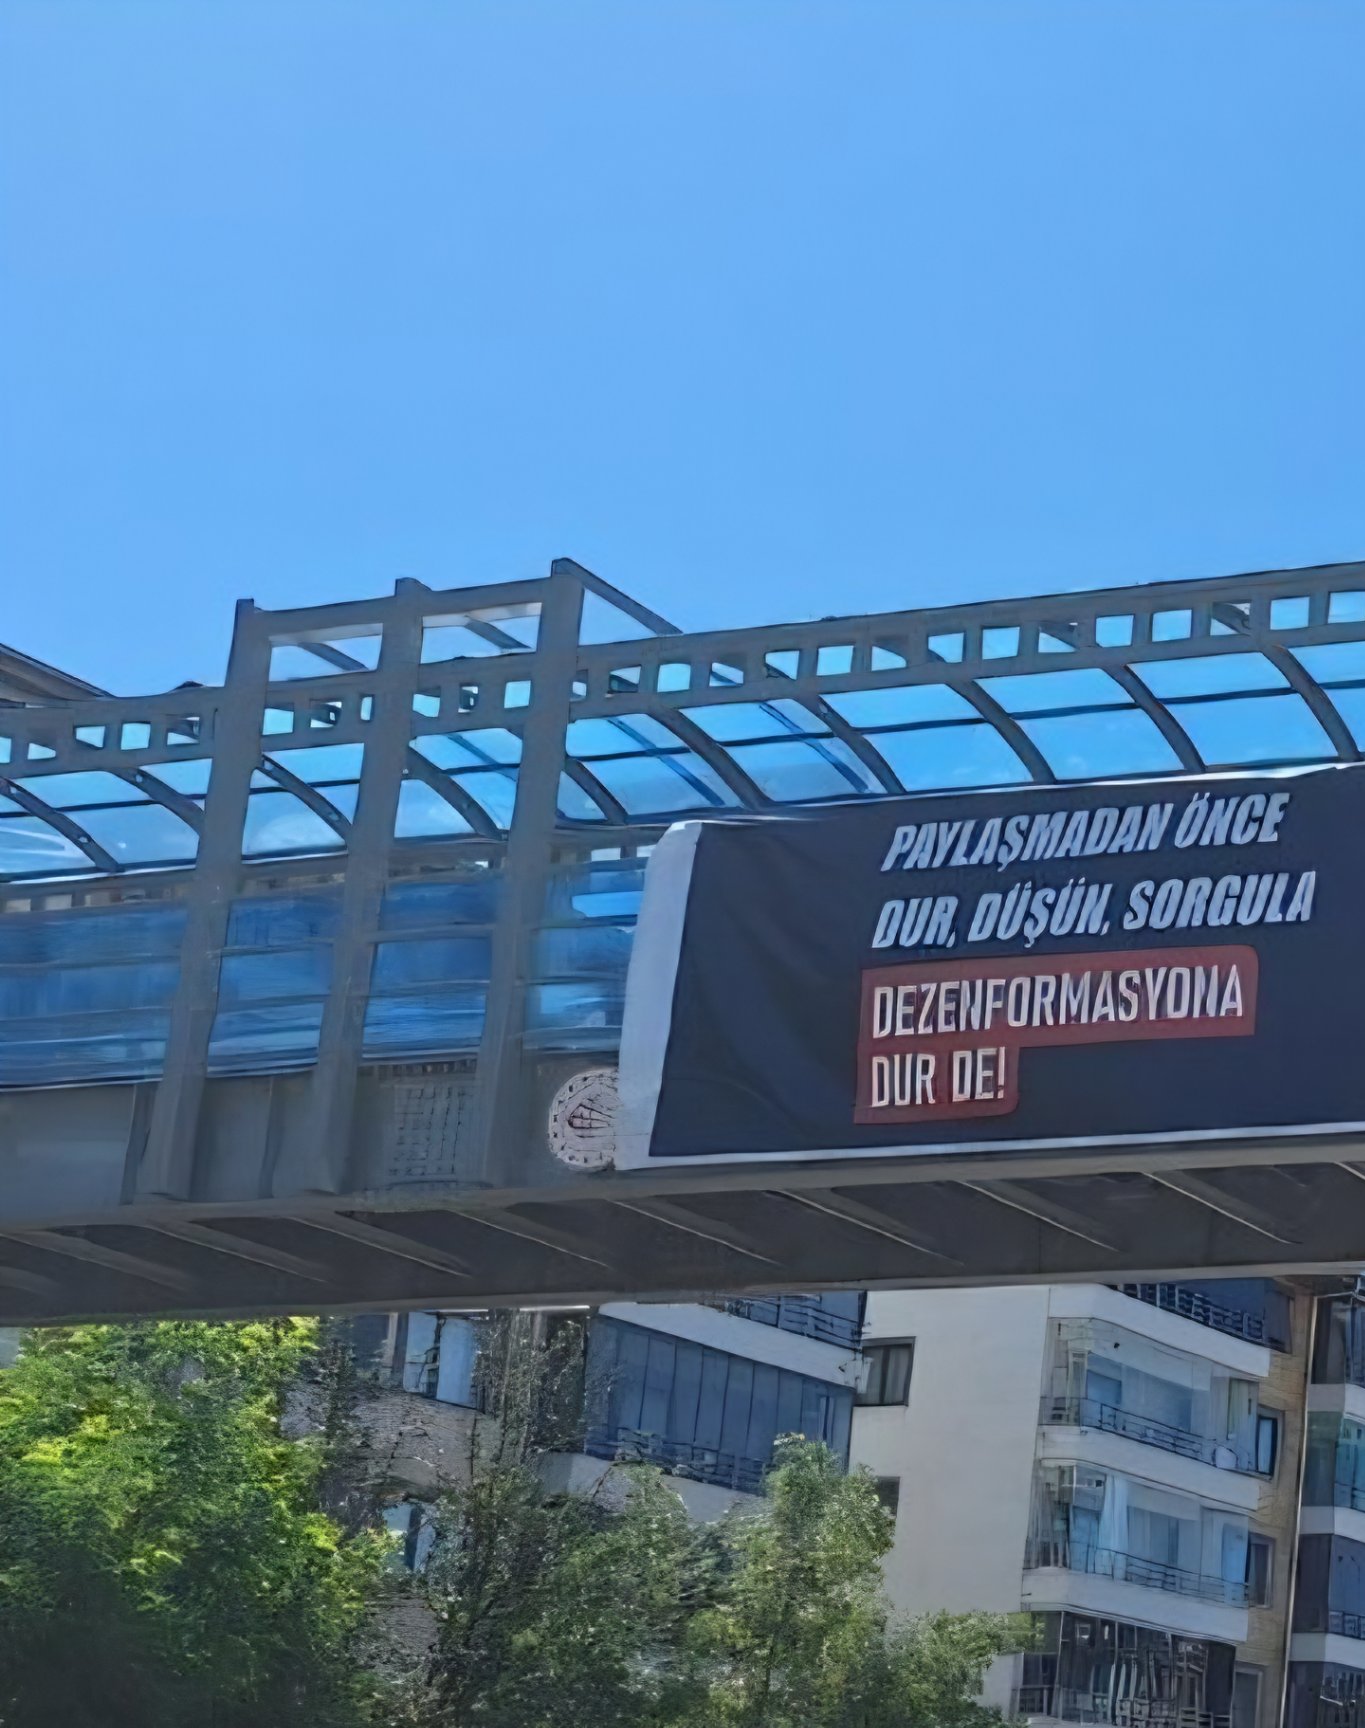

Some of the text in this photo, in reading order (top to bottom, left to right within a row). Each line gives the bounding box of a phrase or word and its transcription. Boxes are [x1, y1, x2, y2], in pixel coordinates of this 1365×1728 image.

[880, 792, 1290, 872] PAYLAŞMADAN ÖNCE
[871, 870, 1317, 949] DUR, DÜŞÜN, SORGULA
[872, 963, 1244, 1039] DEZENFORMASYONA
[871, 1045, 1006, 1108] DUR DE!
